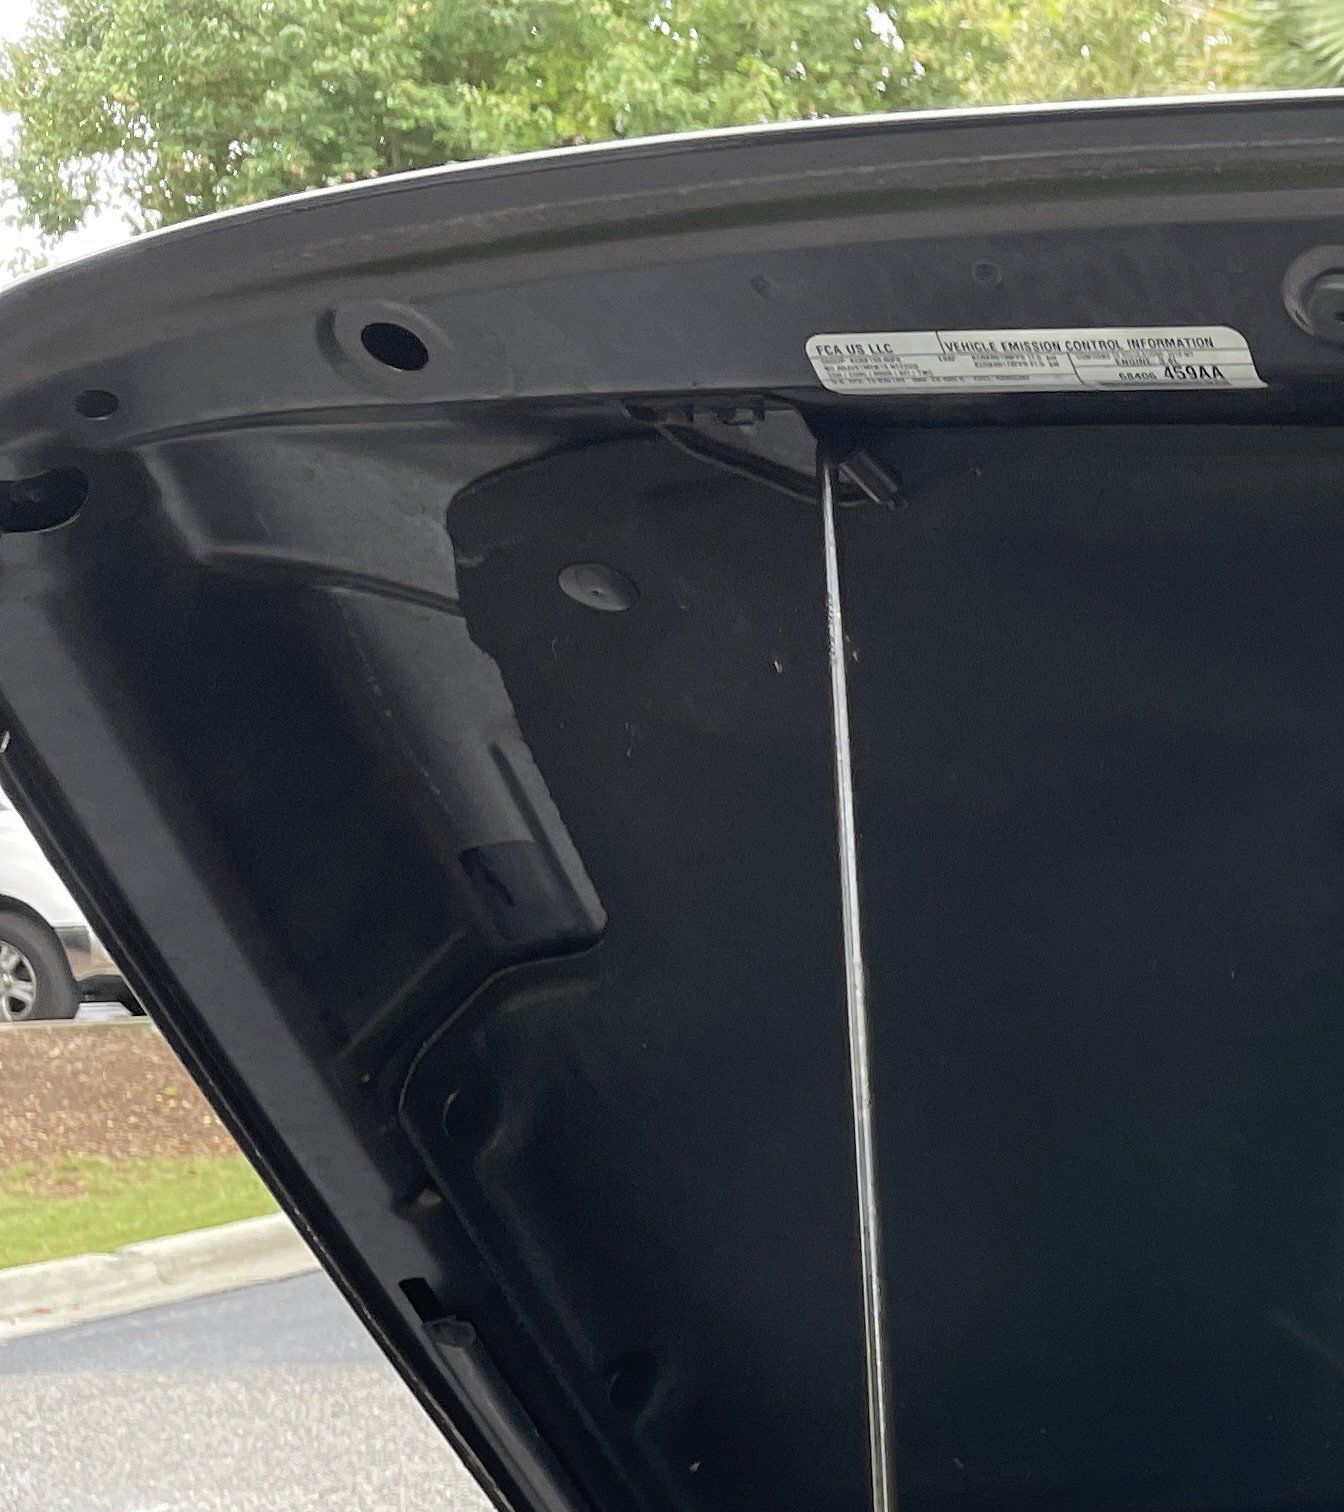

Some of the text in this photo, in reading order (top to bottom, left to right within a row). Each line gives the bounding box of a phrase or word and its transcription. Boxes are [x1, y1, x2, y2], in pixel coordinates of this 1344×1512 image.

[815, 342, 894, 357] FCA US LLC
[943, 336, 1215, 353] VEHICLE EMISSION CONTROL INFORMATION
[1163, 364, 1226, 380] 459AA
